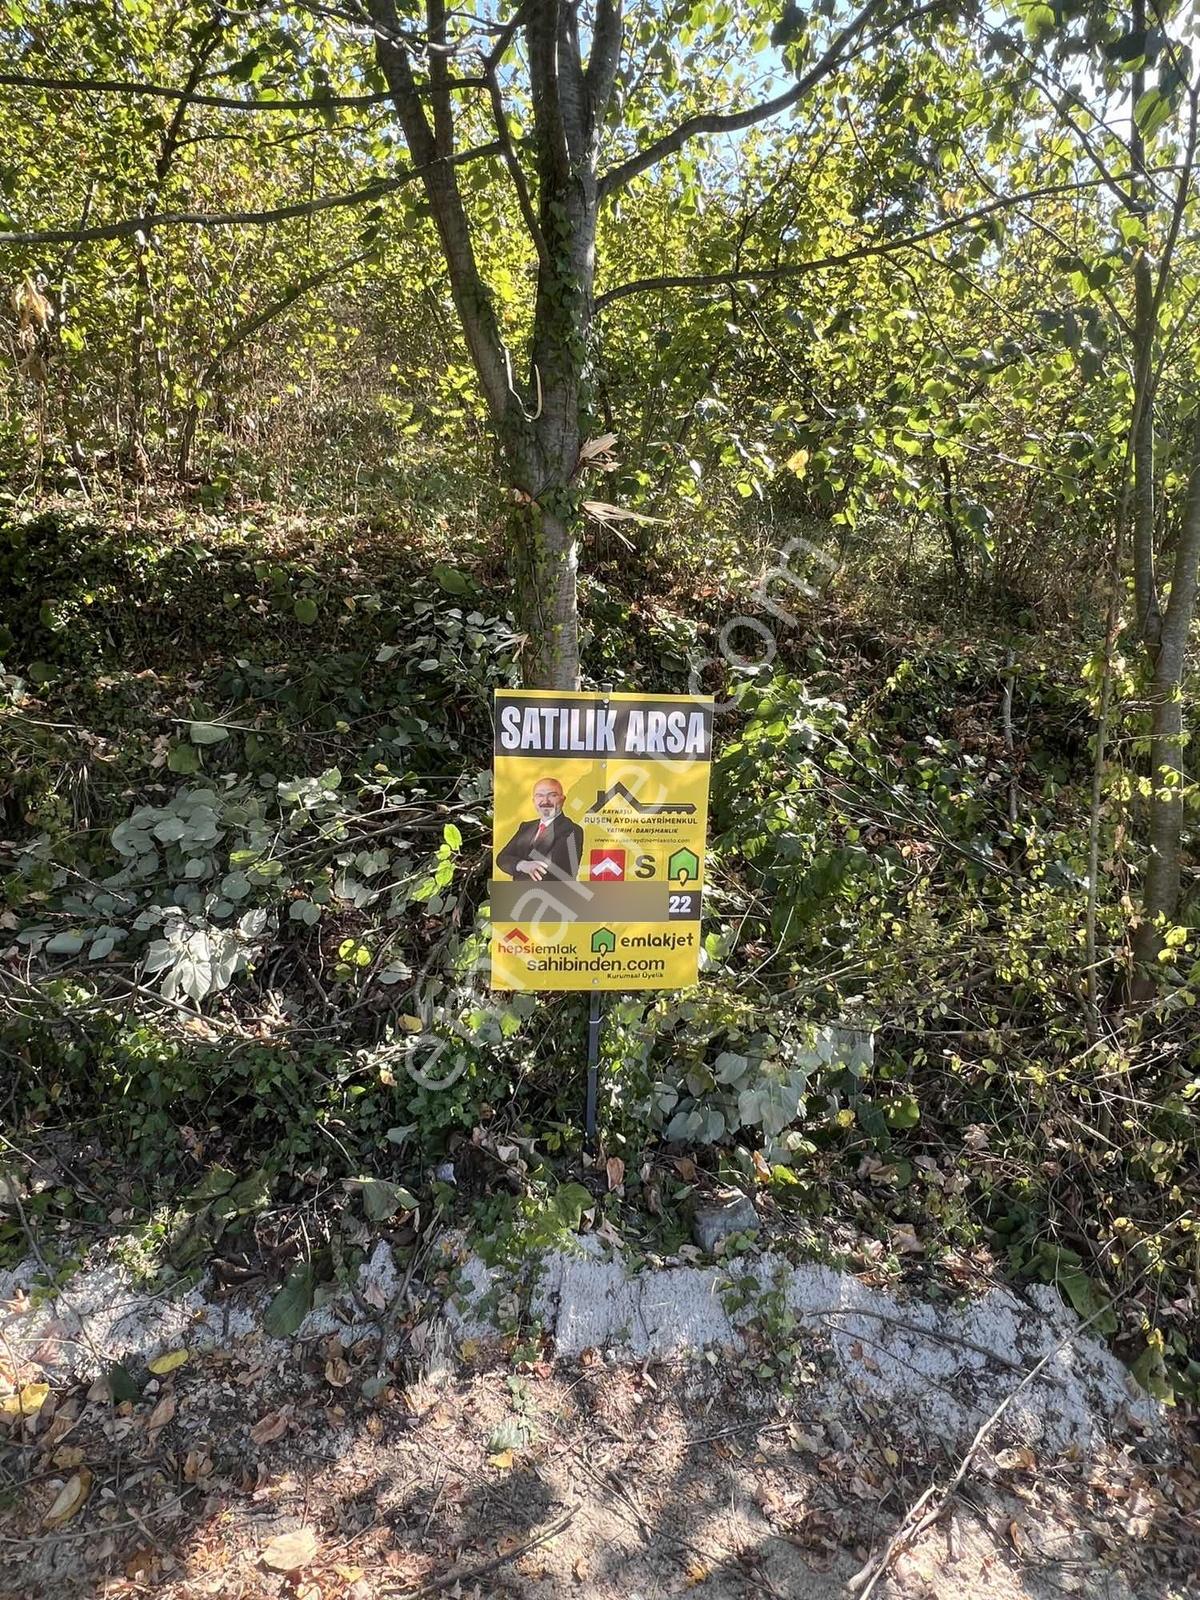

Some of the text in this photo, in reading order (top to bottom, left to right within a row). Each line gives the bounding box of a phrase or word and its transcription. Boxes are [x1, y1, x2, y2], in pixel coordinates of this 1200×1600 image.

[501, 706, 705, 754] SATILIK ARSA
[584, 816, 698, 825] RUŞEN AYDIN GAYRİMENKUL
[635, 855, 656, 878] S
[668, 895, 692, 913] 22
[498, 933, 694, 955] hepsiemlak emlakjet
[527, 957, 665, 971] sahibinden.com
[642, 972, 664, 980] Üyelik
